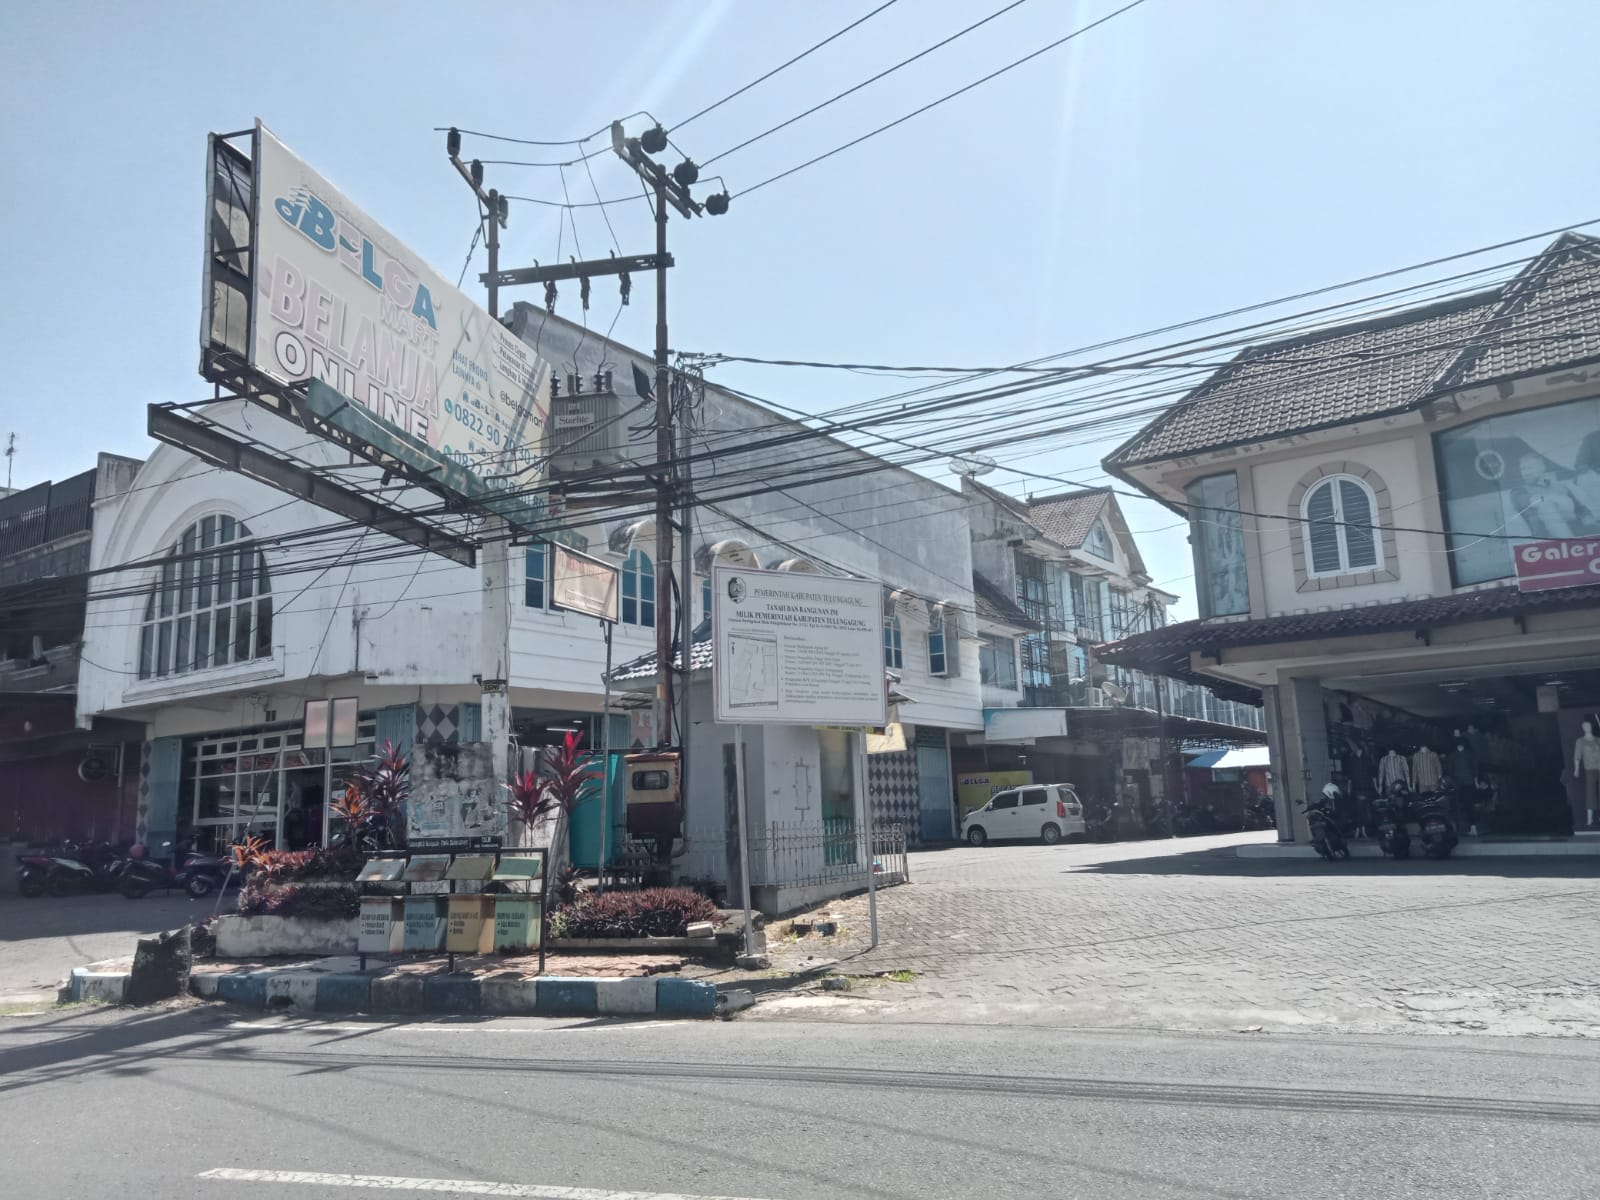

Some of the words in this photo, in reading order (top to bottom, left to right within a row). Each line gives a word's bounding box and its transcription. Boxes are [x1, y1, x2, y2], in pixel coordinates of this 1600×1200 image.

[270, 256, 438, 418] BELANJA
[275, 330, 429, 444] ONLINE
[455, 403, 483, 437] 0822
[486, 425, 500, 446] 90
[753, 588, 791, 600] PEMERINTAH
[791, 591, 822, 602] KABUPATEN
[736, 610, 754, 619] MILIK
[755, 612, 793, 622] PEMERINTAH
[793, 614, 826, 624] KABUPATEN
